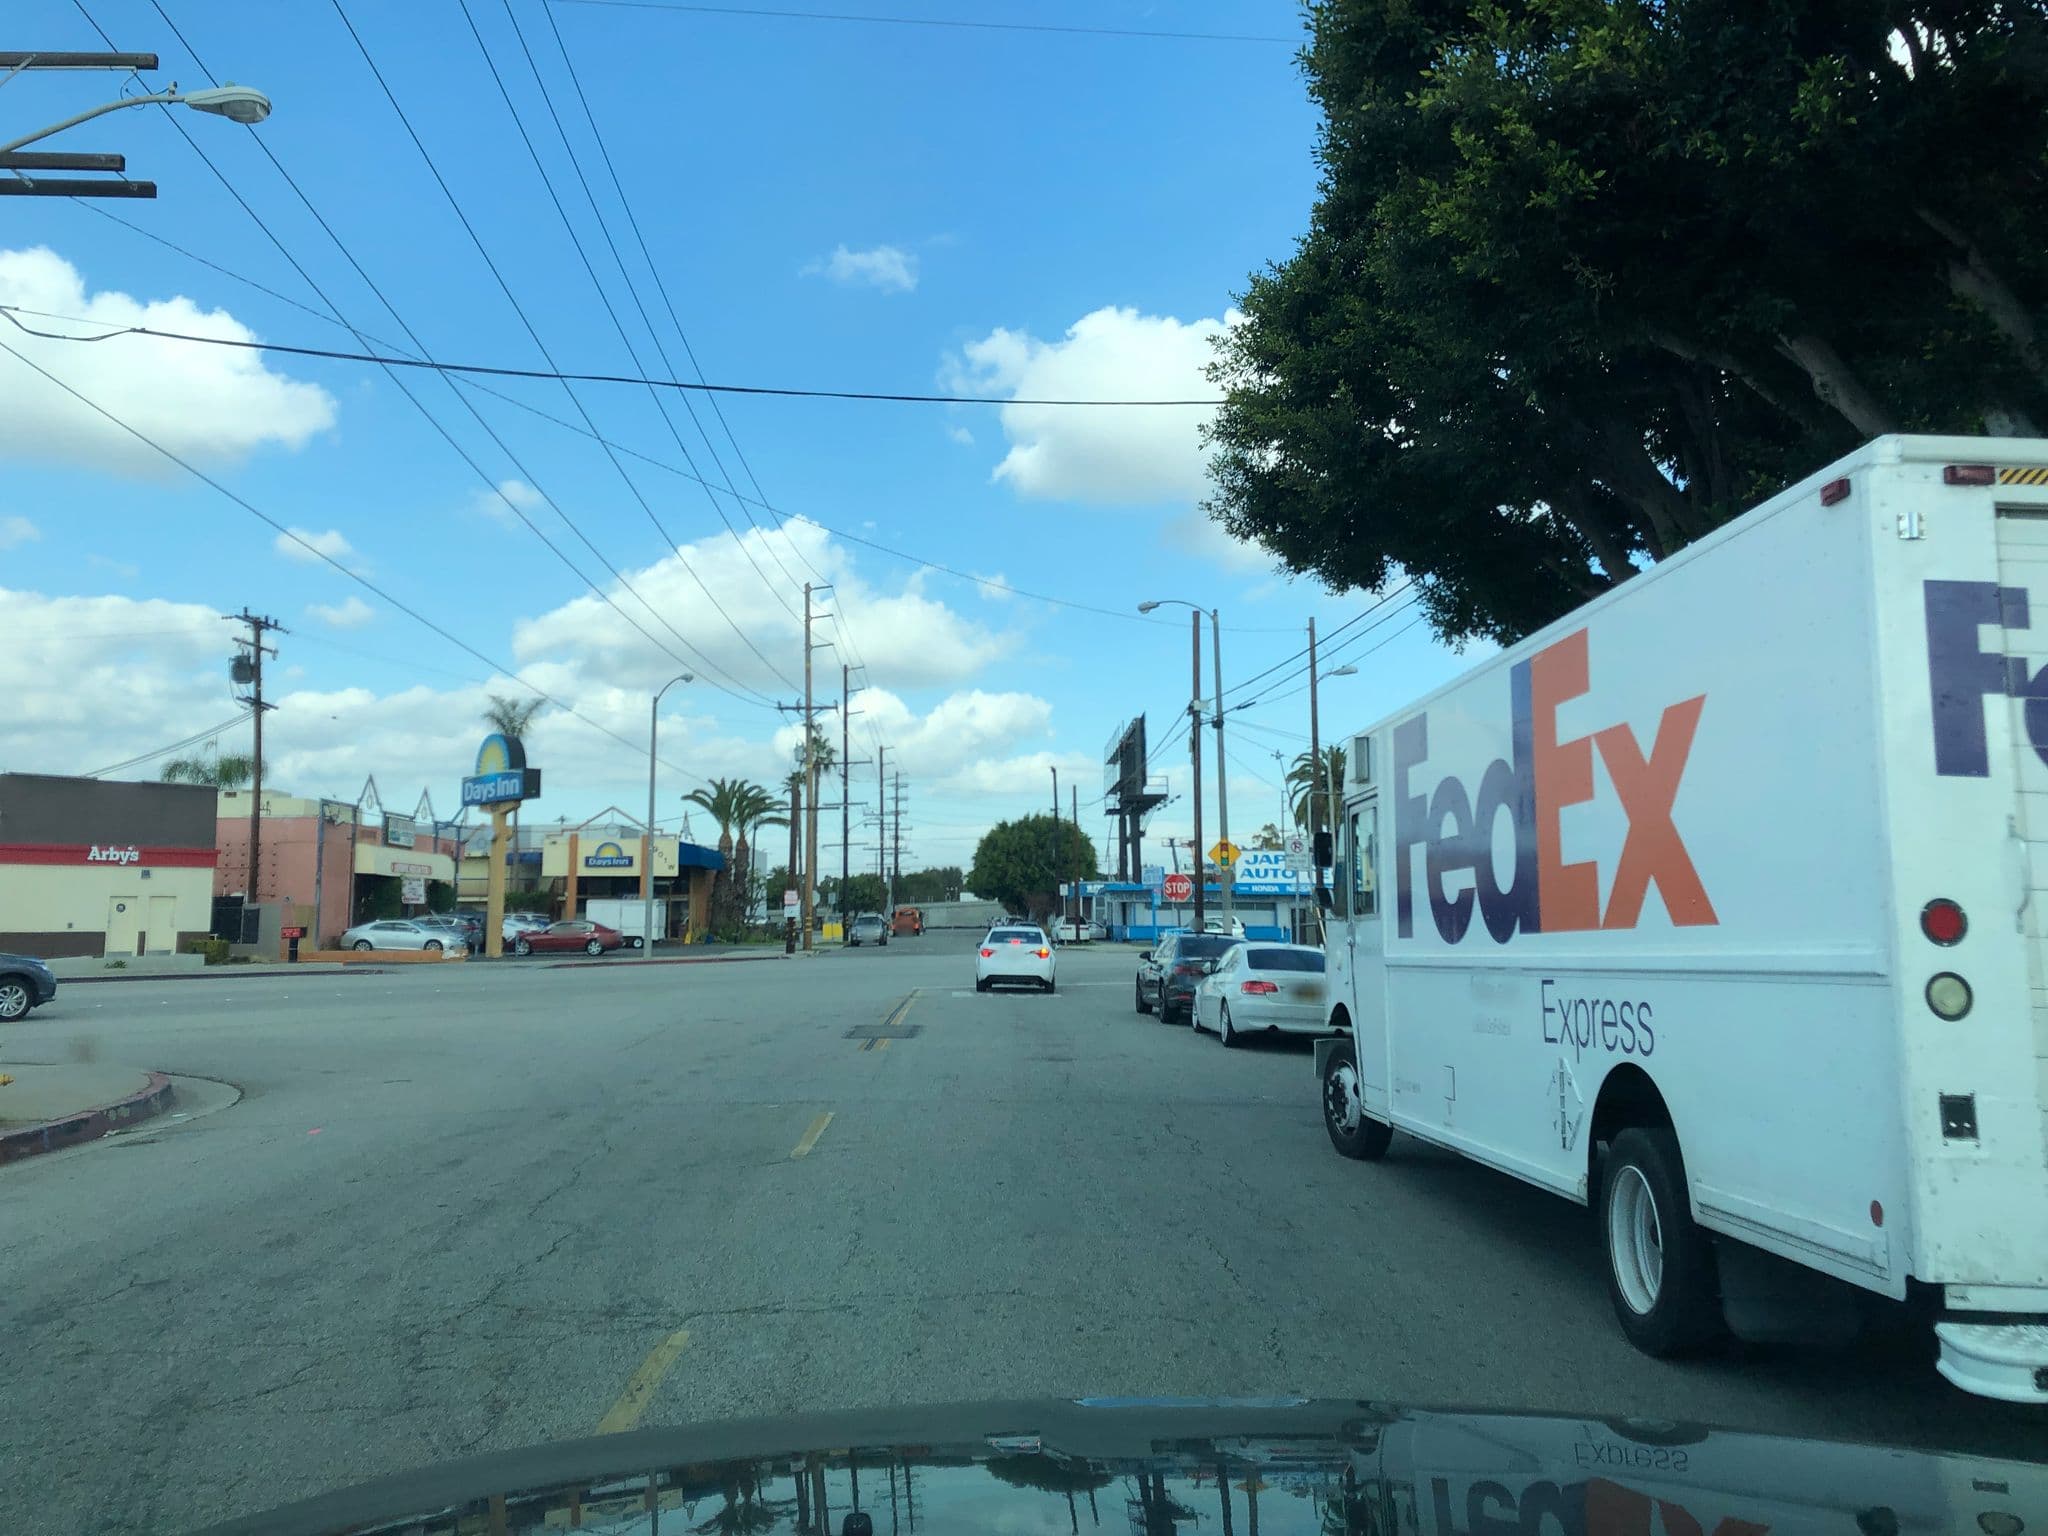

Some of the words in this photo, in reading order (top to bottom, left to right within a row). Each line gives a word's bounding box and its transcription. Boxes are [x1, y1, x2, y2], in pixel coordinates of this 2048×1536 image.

[1924, 579, 2048, 777] F
[464, 781, 495, 802] Days
[496, 776, 520, 797] Inn
[1393, 627, 1720, 945] FedEx
[87, 845, 139, 866] Arby's
[588, 857, 612, 866] Days
[613, 857, 630, 865] Inn
[1244, 854, 1286, 865] JAP
[1240, 868, 1297, 879] AUTO
[1165, 882, 1190, 895] STOP
[1541, 978, 1655, 1064] Express
